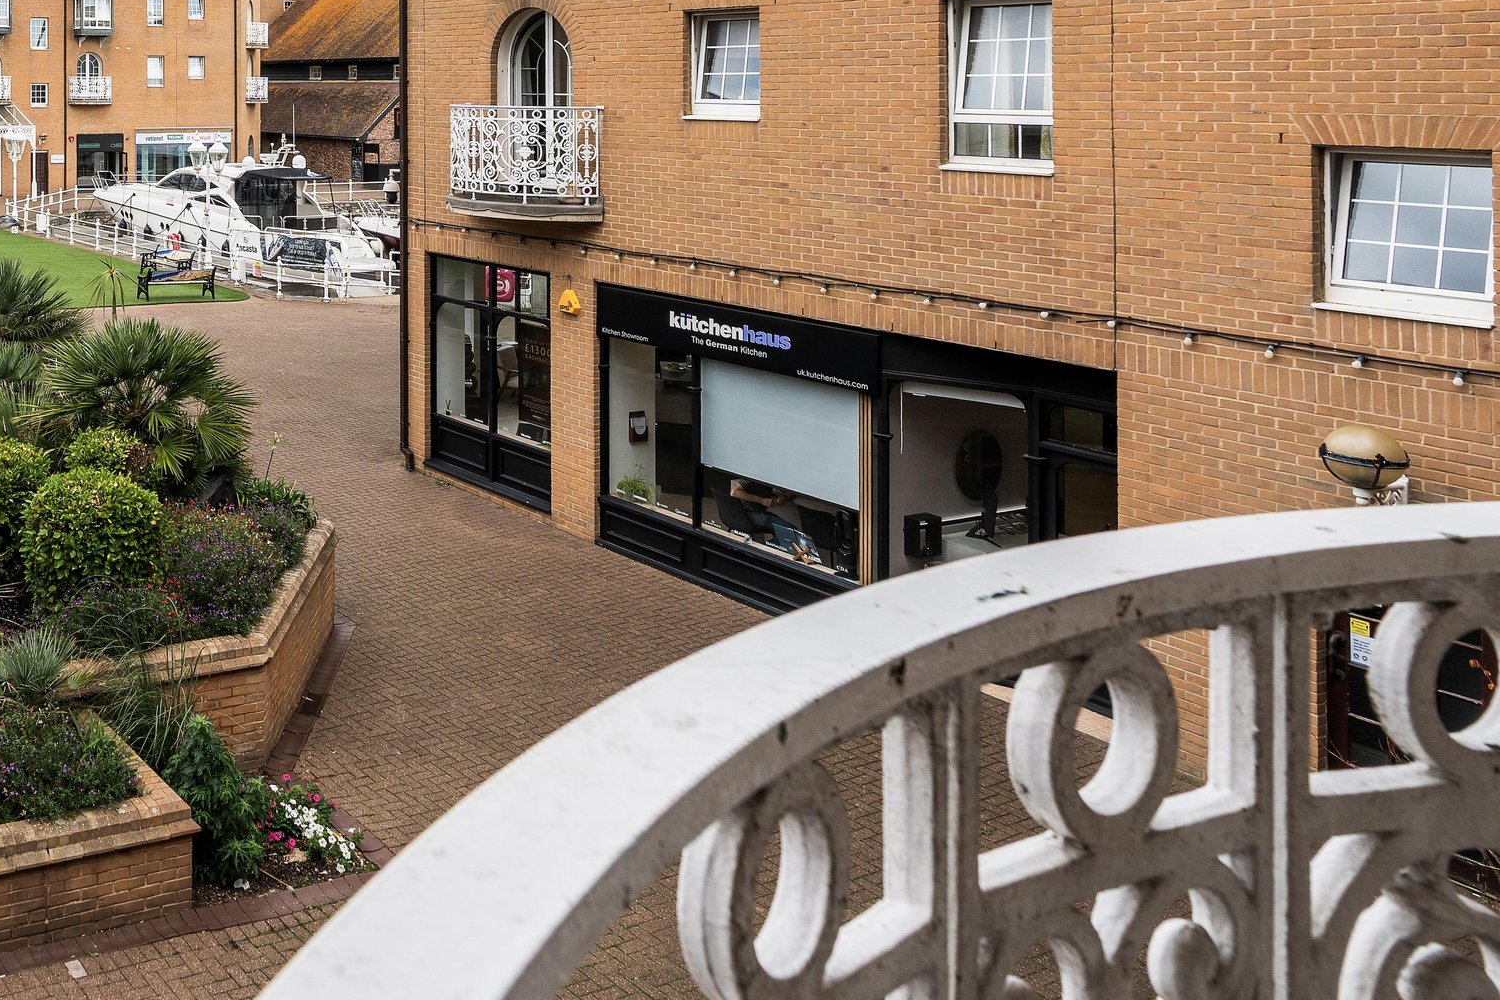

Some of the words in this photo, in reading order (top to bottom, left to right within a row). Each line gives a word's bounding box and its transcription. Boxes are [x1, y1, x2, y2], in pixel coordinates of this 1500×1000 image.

[236, 243, 258, 254] Ancasta
[601, 326, 621, 337] Kitchen
[621, 329, 649, 343] Showroom
[669, 310, 792, 351] kütchenhaus
[691, 335, 705, 347] The
[705, 338, 739, 353] German
[739, 345, 768, 359] Kitchen
[525, 354, 551, 364] CASHBAC
[796, 369, 869, 390] uk.kutchenhaus.com
[836, 565, 849, 573] CDA
